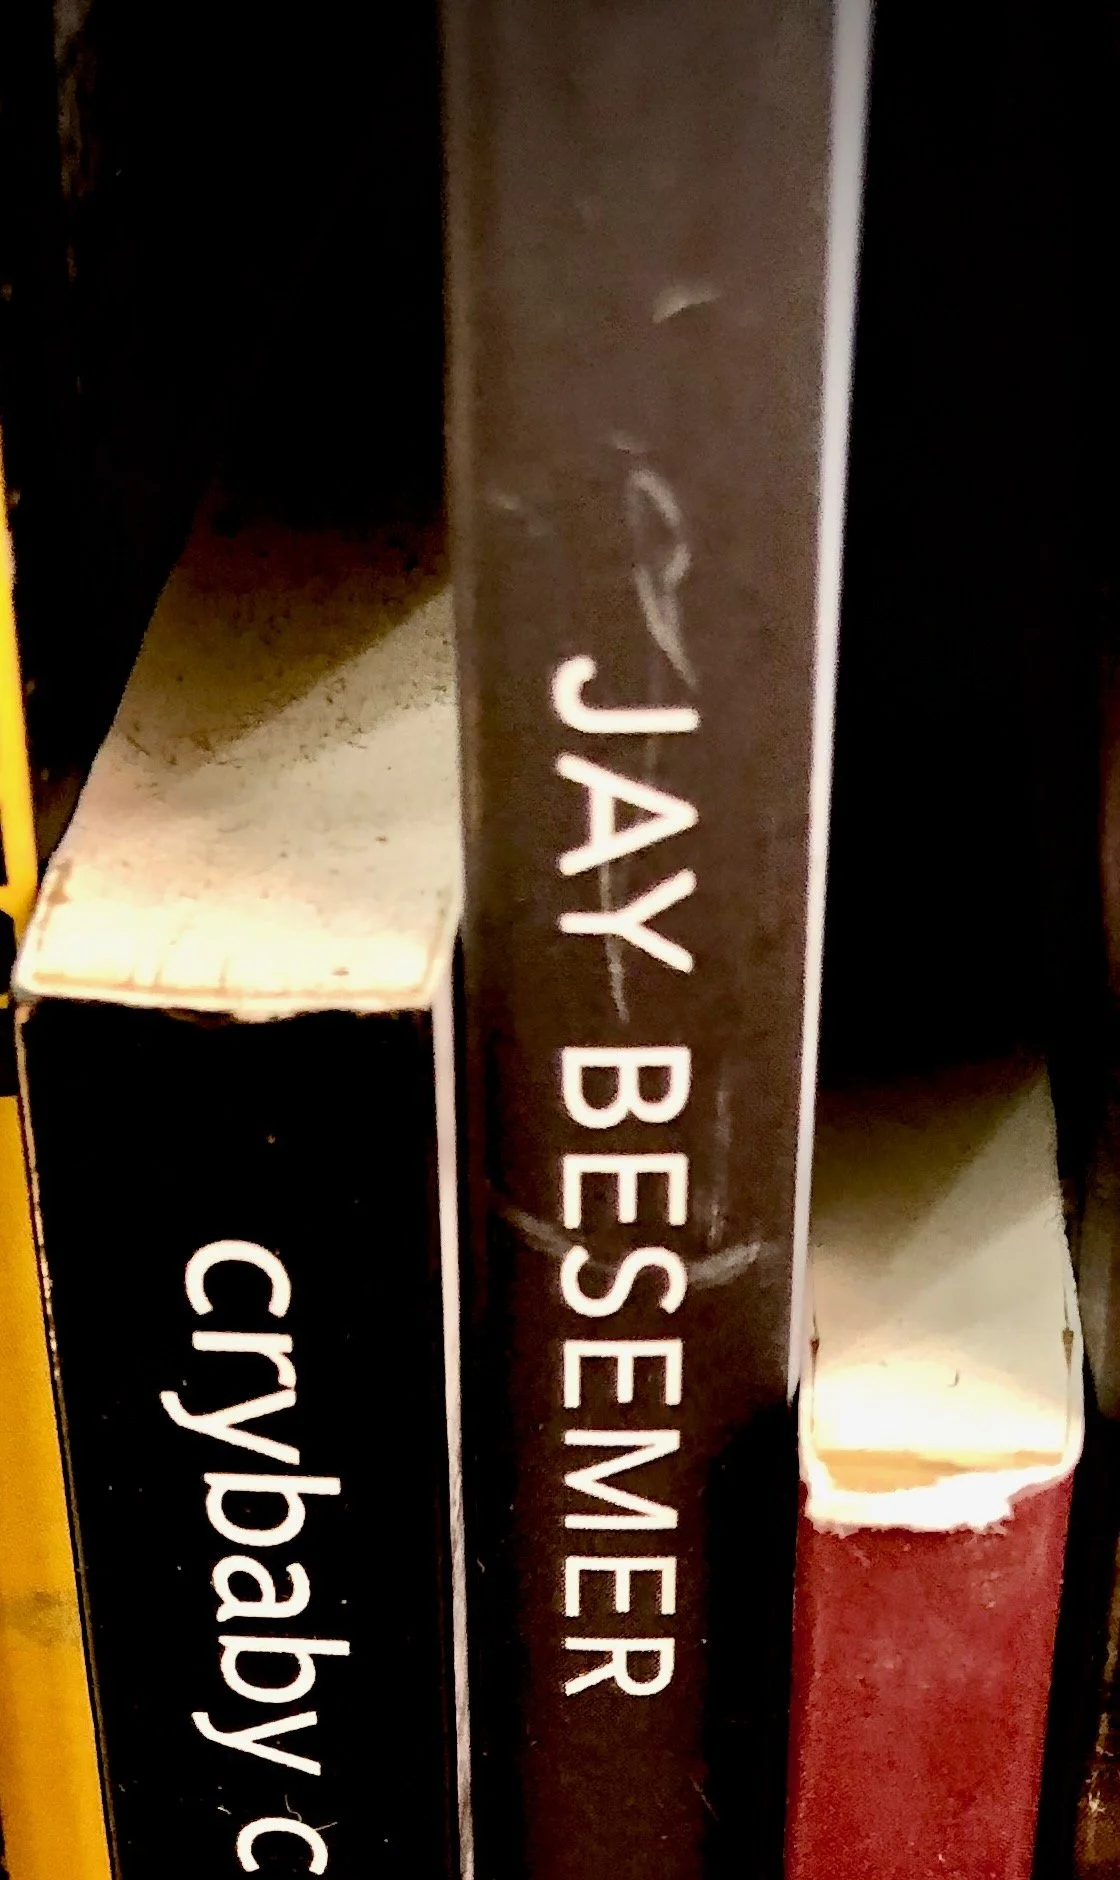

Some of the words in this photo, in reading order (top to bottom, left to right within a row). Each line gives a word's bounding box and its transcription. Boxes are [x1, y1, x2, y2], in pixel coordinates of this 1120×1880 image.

[551, 655, 701, 976] JAY
[160, 1240, 350, 1776] crybaby
[560, 1046, 692, 1696] BESEMER
